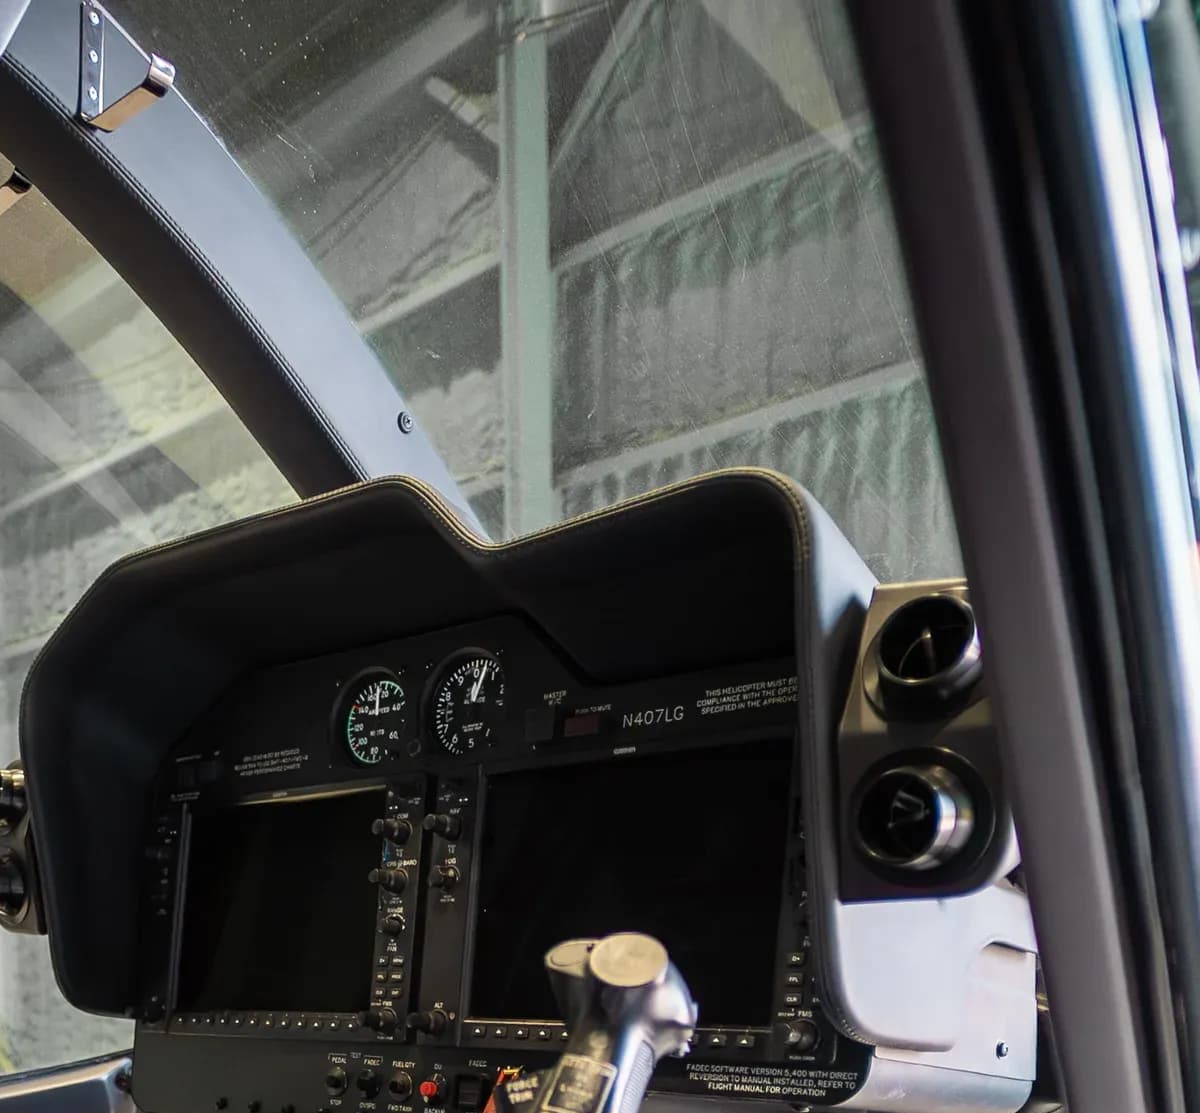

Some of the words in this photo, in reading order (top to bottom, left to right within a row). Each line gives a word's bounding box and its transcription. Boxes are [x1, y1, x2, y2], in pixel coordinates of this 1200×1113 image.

[473, 668, 480, 679] 0
[457, 675, 464, 687] 9
[705, 688, 721, 697] THIS
[722, 681, 765, 694] HELICOPTER
[768, 678, 787, 688] MUST
[696, 694, 741, 707] COMPLIANCE
[743, 690, 761, 700] WITH
[762, 688, 776, 697] THE
[391, 703, 401, 711] 40
[701, 704, 737, 715] SPECIFIED
[737, 702, 746, 710] IN
[747, 699, 761, 708] THE
[622, 705, 685, 729] N407LG
[451, 733, 459, 744] 6
[468, 737, 475, 749] 5
[797, 1010, 813, 1018] FMS
[331, 1056, 347, 1065] PEDAL
[363, 1058, 381, 1066] FADEC
[468, 1059, 488, 1068] FADEC
[686, 1063, 710, 1072] FADEC
[711, 1065, 750, 1074] SOFTWARE
[750, 1067, 783, 1077] VERSION
[808, 1070, 829, 1079] WITH
[829, 1071, 859, 1080] DIRECT
[689, 1072, 729, 1082] REVERSION
[729, 1075, 740, 1083] TO
[741, 1075, 772, 1085] MANUAL
[773, 1077, 817, 1089] INSTALLED,
[818, 1079, 844, 1089] REFER
[845, 1081, 856, 1090] TO
[707, 1081, 733, 1091] FLIGHT
[734, 1083, 765, 1093] MANUAL
[765, 1085, 781, 1094] FOR
[781, 1086, 826, 1097] OPERATION
